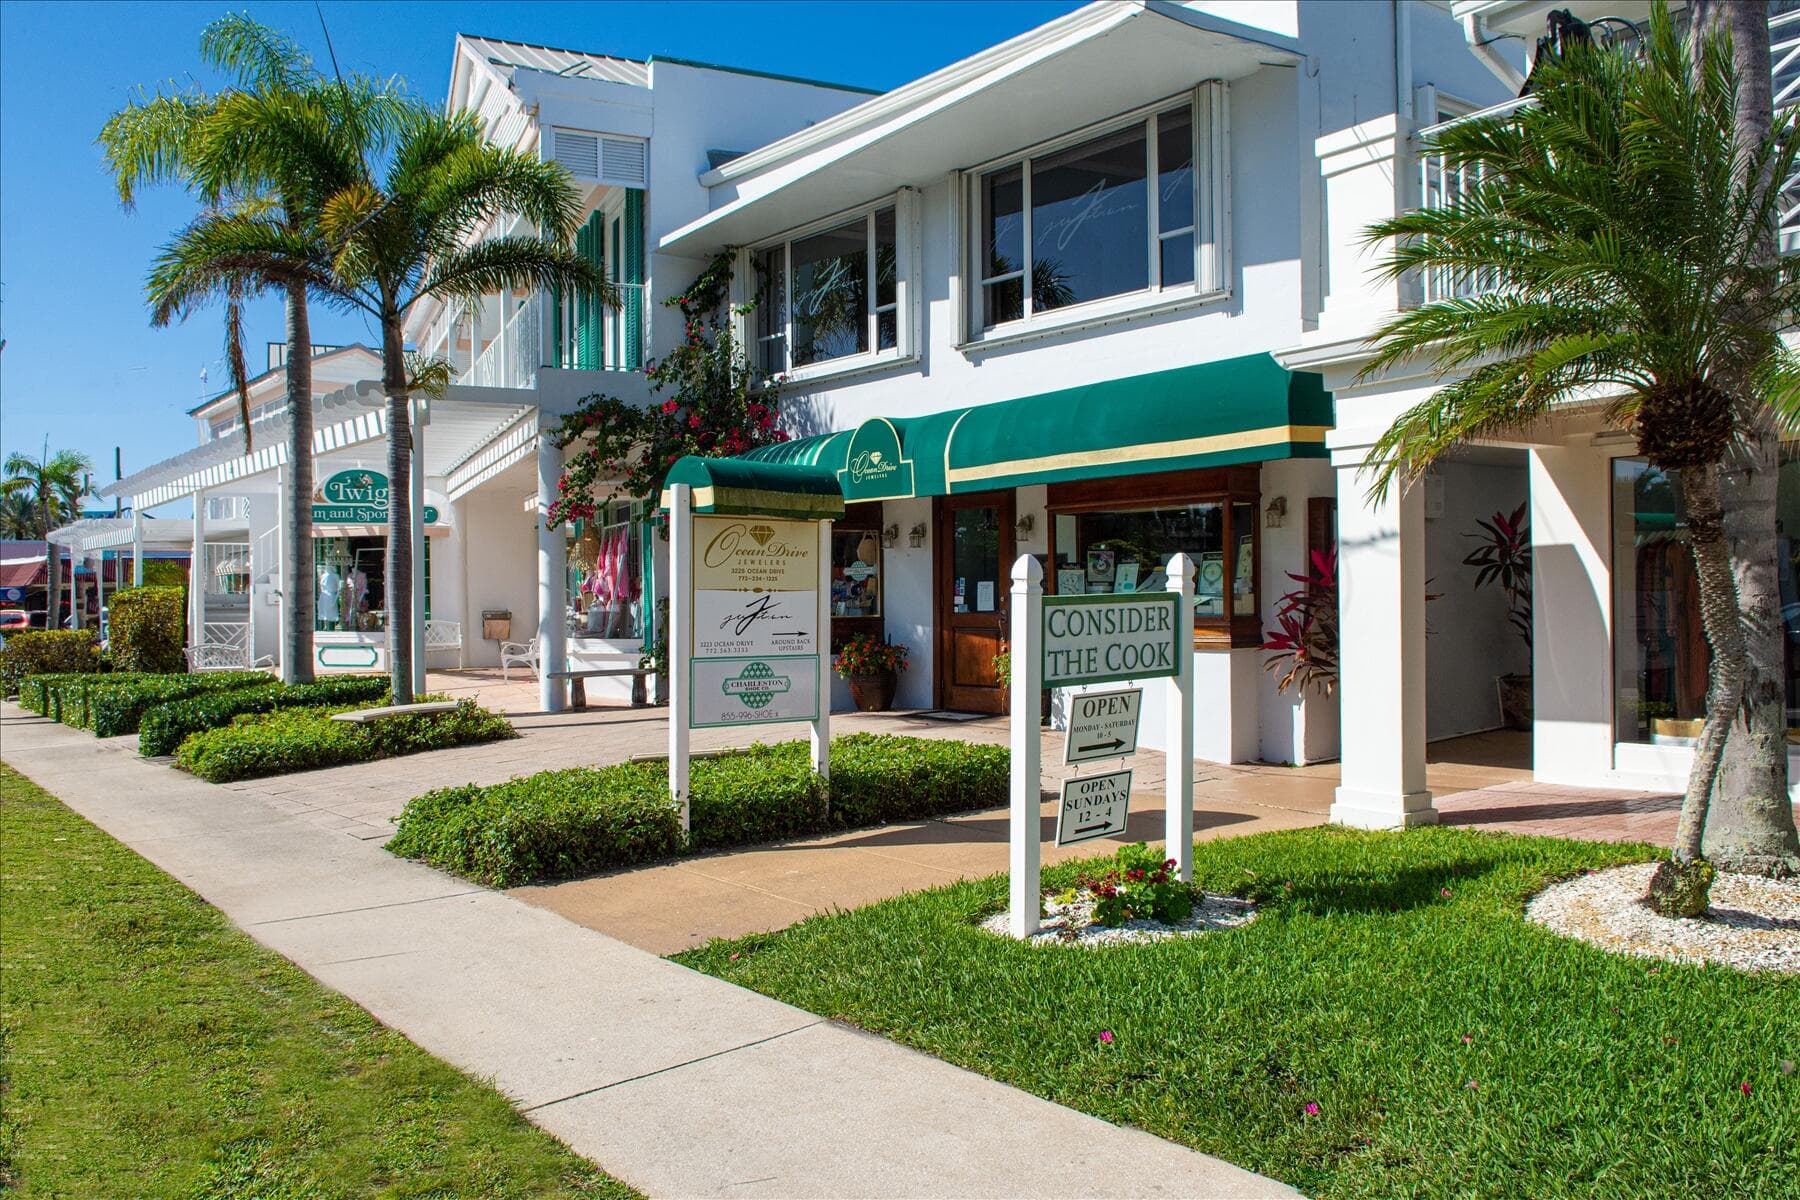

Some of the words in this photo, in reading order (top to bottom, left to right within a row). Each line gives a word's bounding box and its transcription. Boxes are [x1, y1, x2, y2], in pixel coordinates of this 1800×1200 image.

[850, 450, 878, 484] Ocean
[878, 461, 897, 473] Drive
[329, 477, 389, 506] Twig
[329, 508, 353, 519] and
[704, 524, 765, 568] Ocean
[766, 542, 808, 558] Drive
[1049, 606, 1171, 638] CONSIDER
[714, 640, 734, 648] OCEAN
[1047, 647, 1098, 677] THE
[1106, 642, 1171, 671] COOK
[731, 679, 783, 688] CHARLESTON
[1083, 695, 1131, 718] OPEN
[1073, 723, 1100, 734] MONDAY
[1104, 719, 1135, 730] SATURDAY
[1081, 778, 1116, 795] OPEN
[1066, 789, 1127, 812] SUNDAYS
[1079, 811, 1091, 823] 12
[1105, 806, 1112, 817] 4
